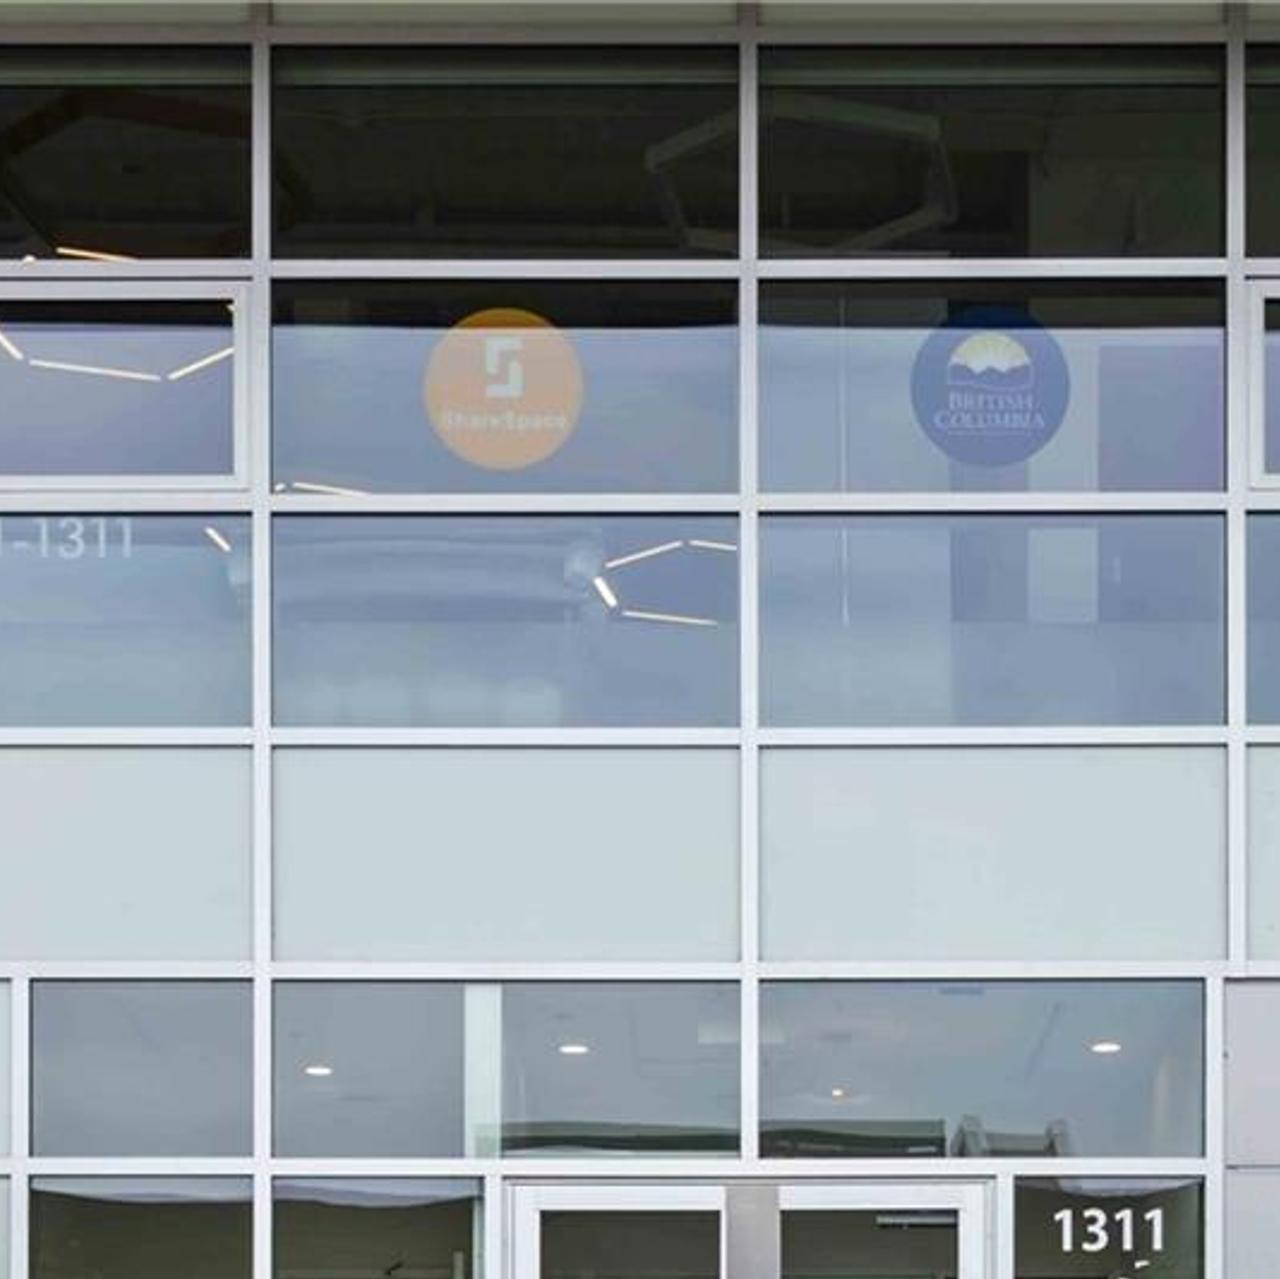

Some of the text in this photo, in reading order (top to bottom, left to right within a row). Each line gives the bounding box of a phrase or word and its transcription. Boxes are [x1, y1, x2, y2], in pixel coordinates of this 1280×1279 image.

[948, 391, 1034, 410] BRITISH
[440, 410, 567, 431] ShareSpace
[933, 410, 1046, 431] COLUMBIA
[1054, 1207, 1163, 1252] 1311
